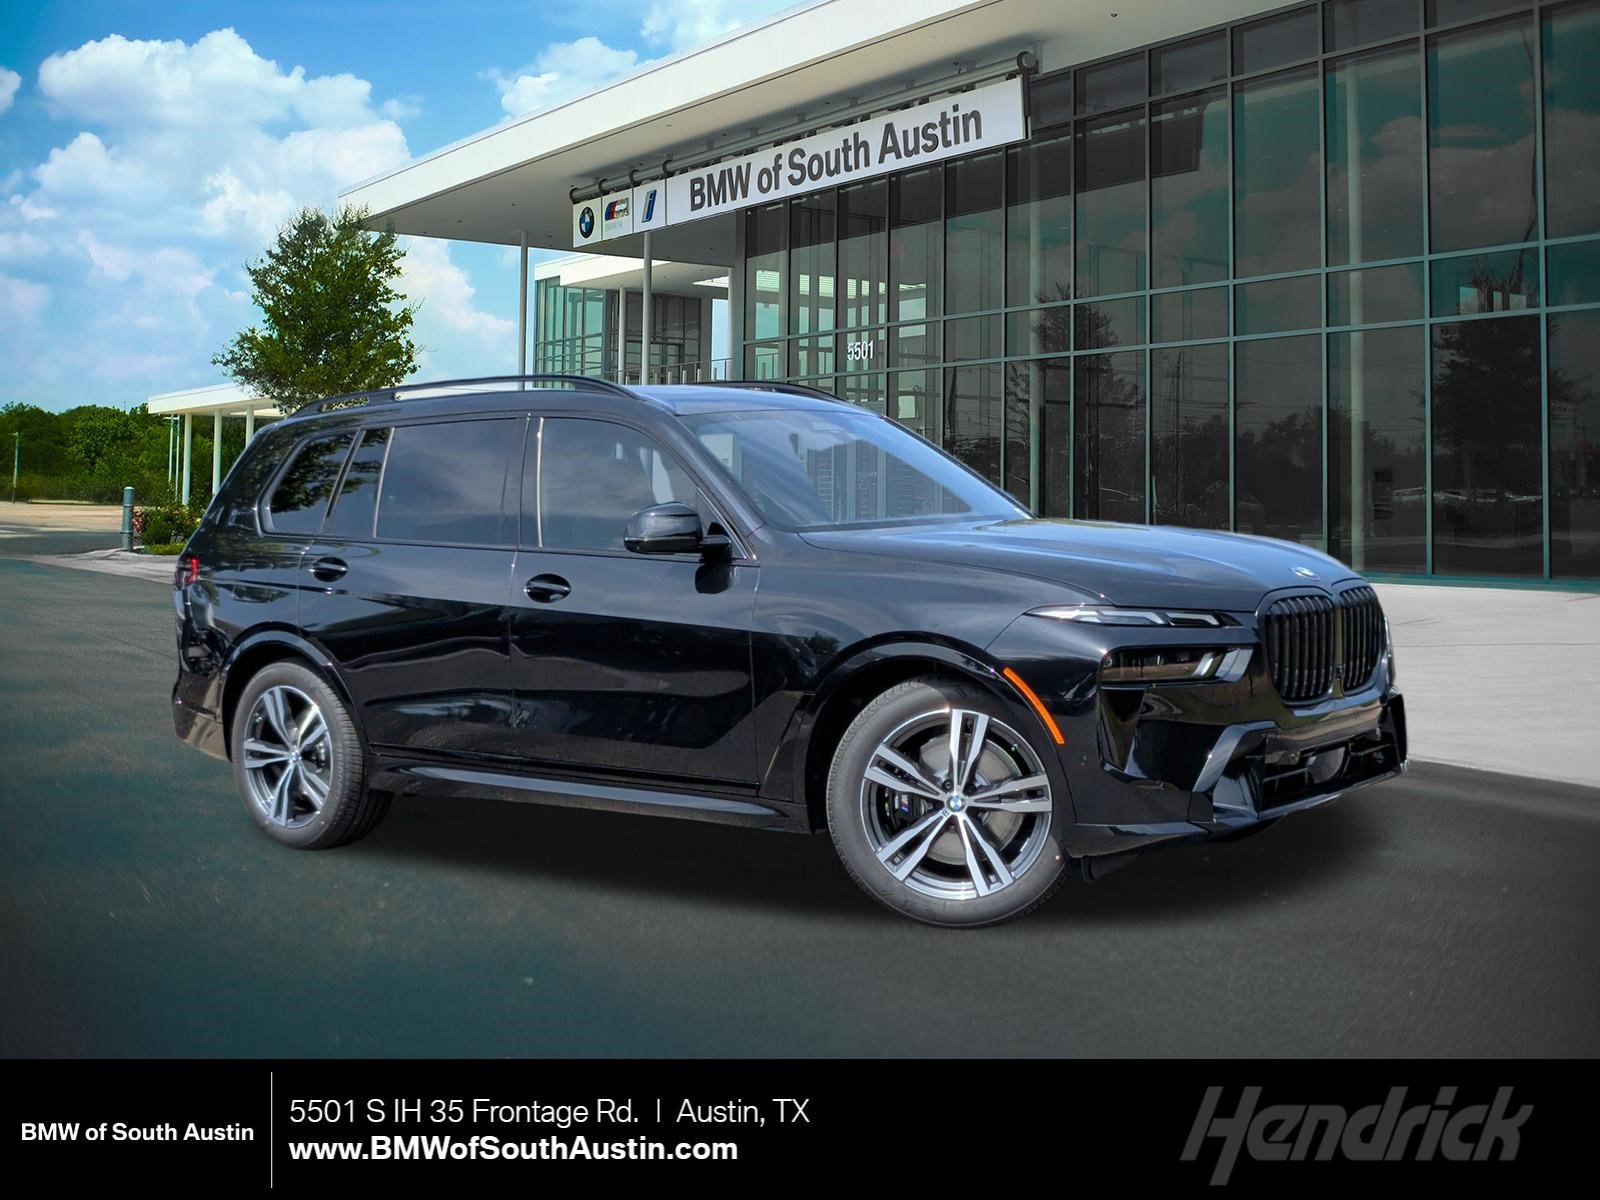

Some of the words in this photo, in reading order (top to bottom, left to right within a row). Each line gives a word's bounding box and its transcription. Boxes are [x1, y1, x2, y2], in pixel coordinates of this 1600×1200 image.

[690, 162, 751, 211] BMW
[757, 153, 783, 194] of
[787, 132, 870, 187] South
[878, 104, 982, 164] Austin
[847, 340, 874, 360] 5501
